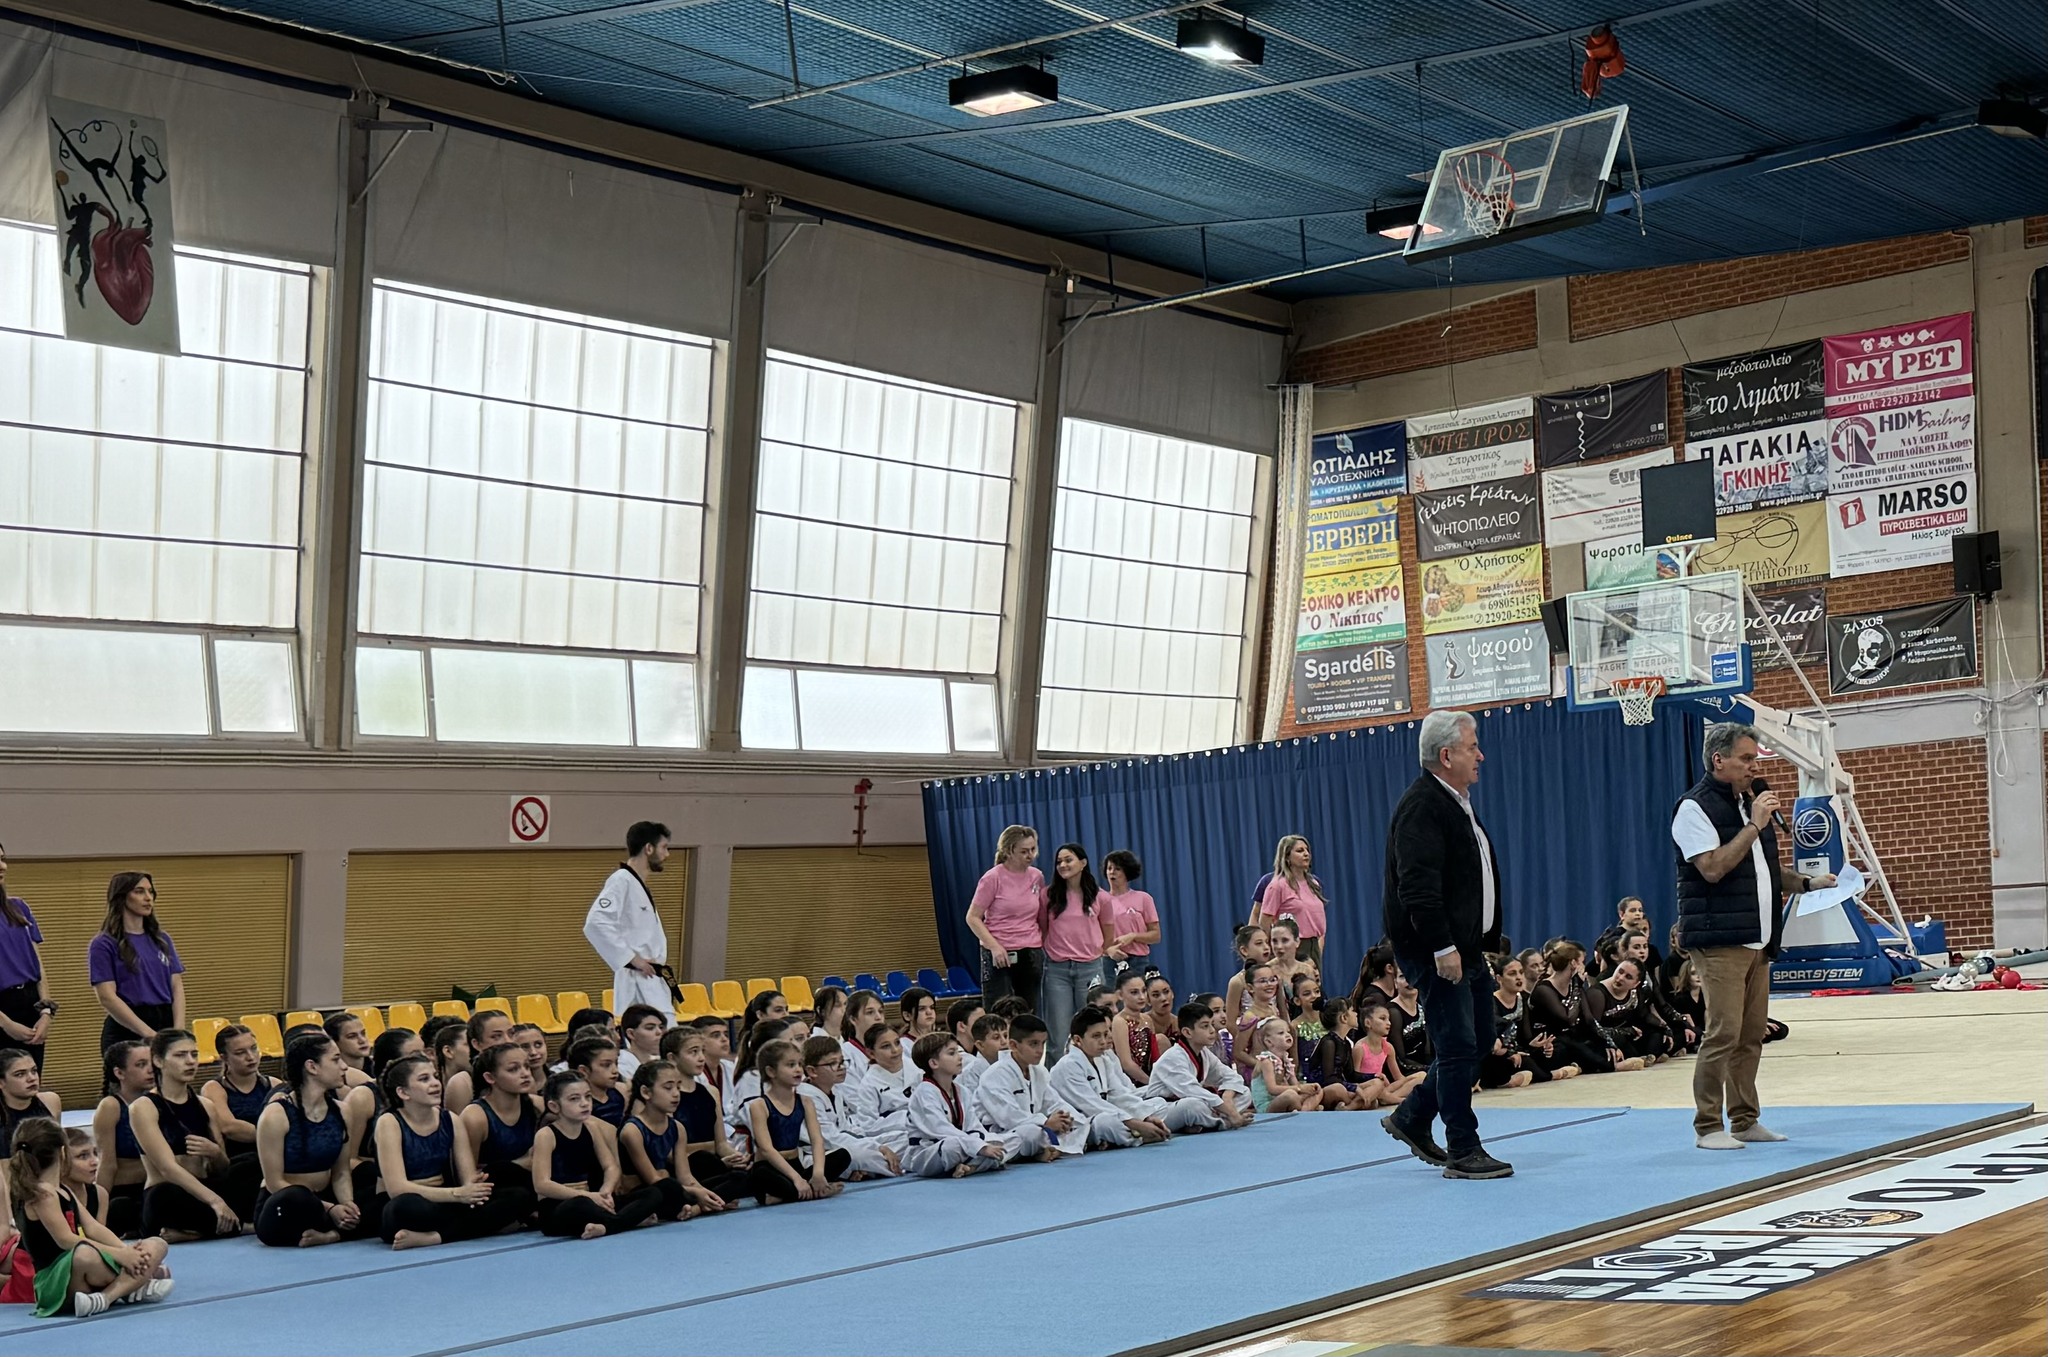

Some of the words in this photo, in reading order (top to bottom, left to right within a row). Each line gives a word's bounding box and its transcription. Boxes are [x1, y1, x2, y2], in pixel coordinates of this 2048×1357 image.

[1717, 352, 1792, 381] μεζεδοπωλείο
[1846, 357, 1890, 384] MY
[1900, 345, 1955, 374] PET
[1552, 395, 1605, 413] VALLIS
[1706, 395, 1728, 415] το
[1733, 377, 1801, 416] λιμάνι
[1881, 395, 1910, 408] 22920
[1913, 389, 1941, 402] 22142
[1879, 408, 1923, 433] HDM
[1918, 408, 1971, 433] Sailing
[1421, 421, 1530, 457] ΗΠΕΙΡΟΣ
[1901, 431, 1949, 447] ΝΑΥΛΩΣΕΙΣ
[1937, 438, 1973, 451] ΣΚΑΦΩΝ
[1312, 448, 1396, 475] ΩΤΙΑΔΗΣ
[1910, 460, 1937, 471] SAILING
[1938, 456, 1963, 467] SCHOOL
[1928, 463, 1973, 476] MANAGEMENT
[1309, 467, 1385, 486] ΥΑΛΟΤΕΧΝΙΚΗ
[1723, 462, 1792, 492] ΓΚΙΝΗΣ
[1418, 494, 1466, 524] Γεύσεις
[1470, 484, 1535, 506] Κρεάτων
[1878, 480, 1967, 517] MARSO
[1432, 511, 1520, 537] ΨΗΤΟΠΩΛΕΙΟ
[1882, 517, 1945, 533] ΠΥΡΟΣΒΕΣΤΙΚΑ
[1946, 511, 1966, 523] ΕΙΔΗ
[1434, 542, 1462, 552] ΚΕΝΤΡΙΚΗ
[1589, 543, 1640, 561] Ψαροτα
[1749, 563, 1811, 581] ΓΡΗΓΟΡΗΣ
[1300, 593, 1344, 612] ΞΟΧΙΚΟ
[1347, 585, 1400, 607] ΚΕΝΤΡΟ
[1488, 594, 1542, 610] 6980514579
[1694, 603, 1823, 635] Chocolat
[1843, 615, 1883, 634] ZAXOS
[1467, 628, 1533, 666] ψαρού
[1331, 679, 1351, 687] ROOMS
[1367, 674, 1395, 683] TRANSFER
[1773, 968, 1863, 981] SPORTSYSTEM
[1615, 1237, 1916, 1300] MEGA
